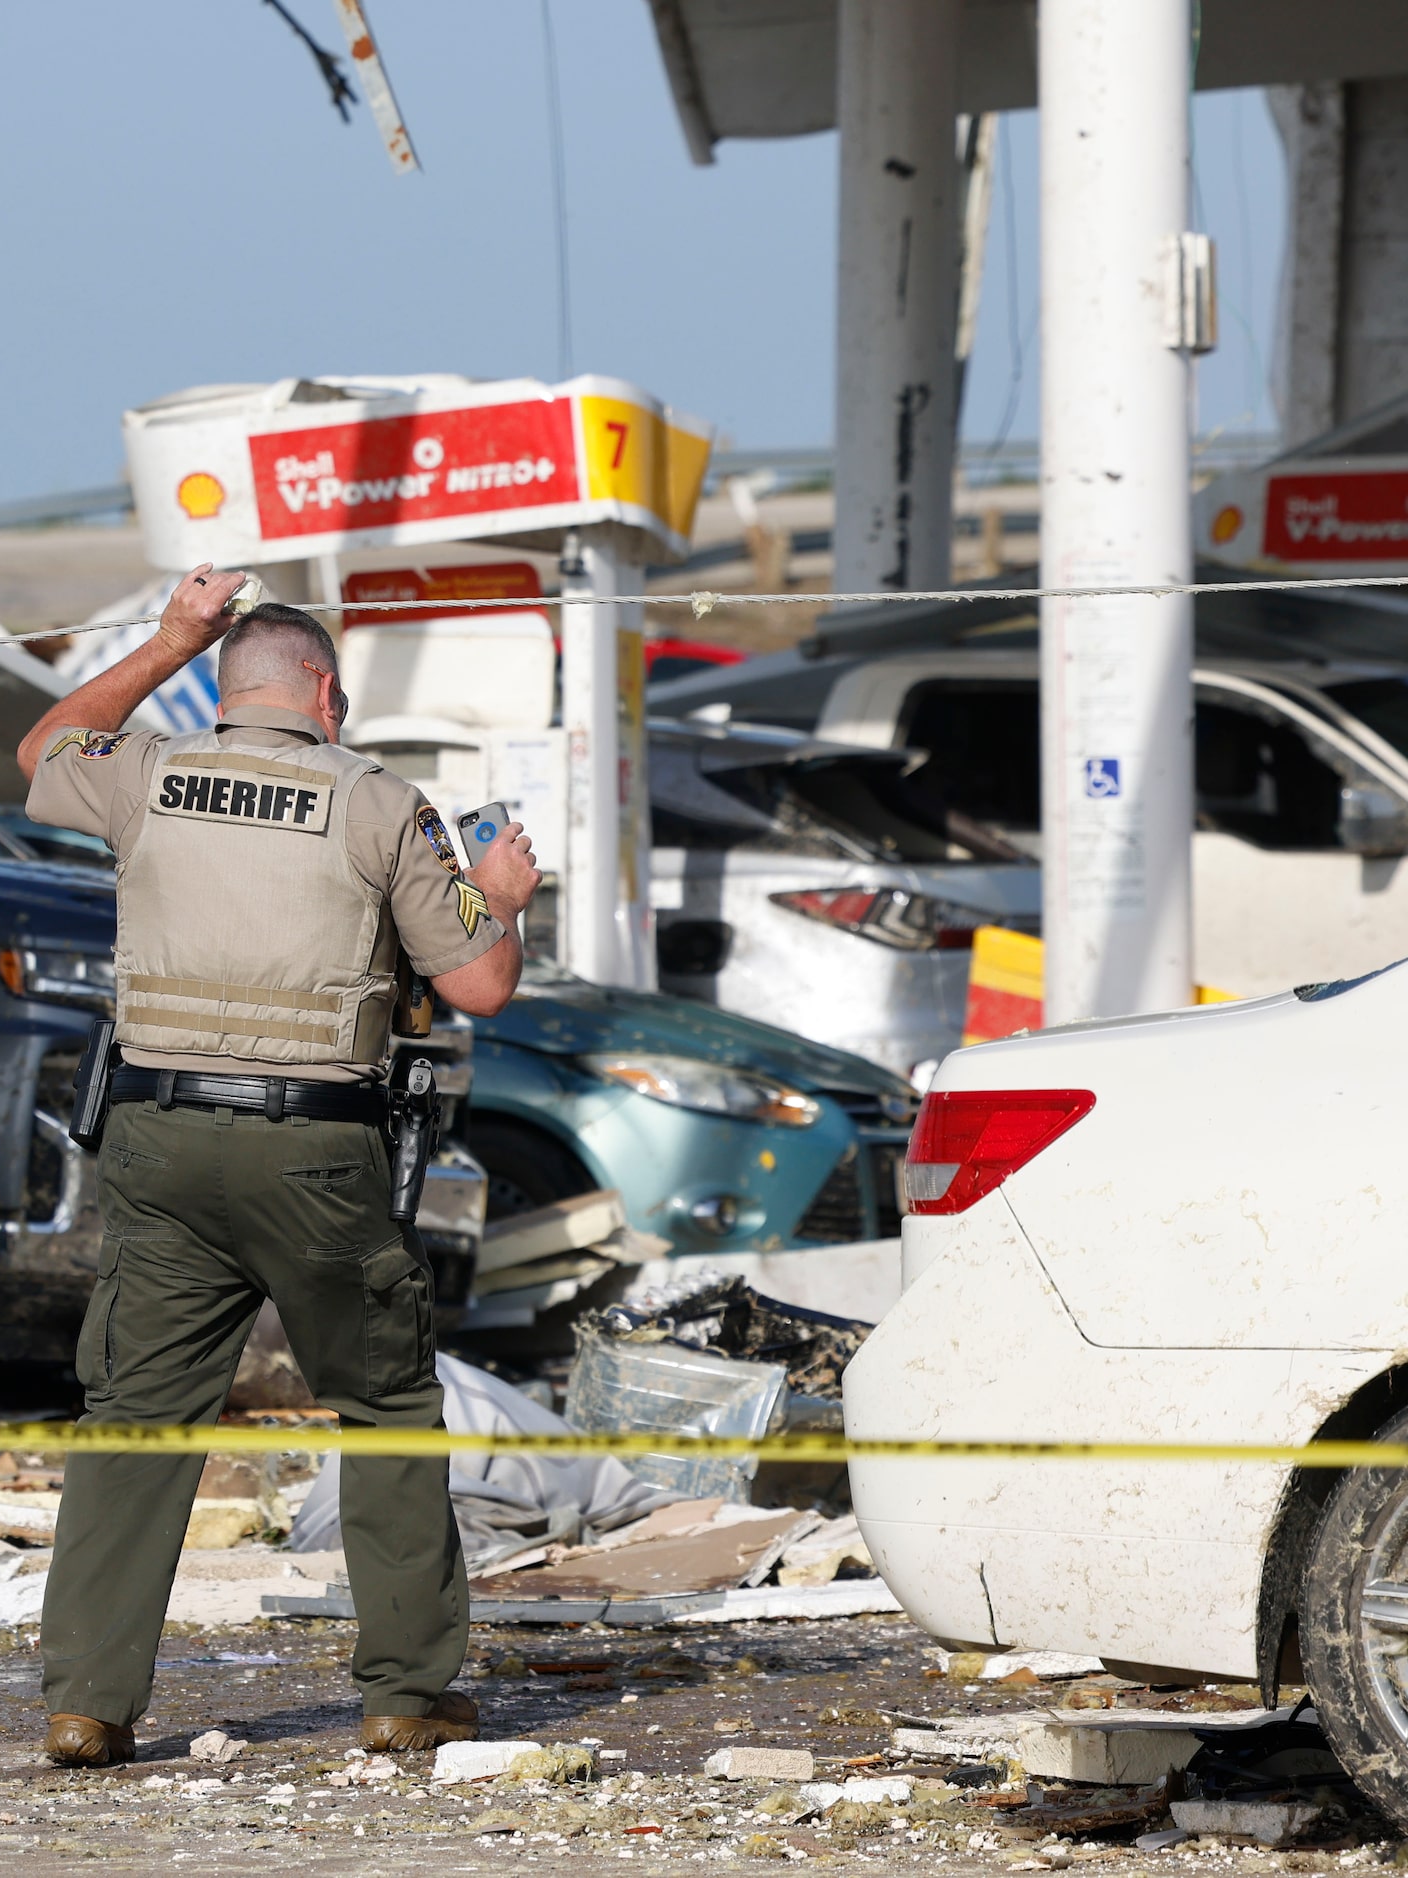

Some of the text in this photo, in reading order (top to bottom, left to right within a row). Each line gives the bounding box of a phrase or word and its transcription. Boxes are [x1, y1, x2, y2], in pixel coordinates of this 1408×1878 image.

[274, 450, 336, 483] Shell
[606, 420, 629, 471] 7
[277, 471, 436, 514] V-Power
[159, 773, 319, 825] SHERIFF
